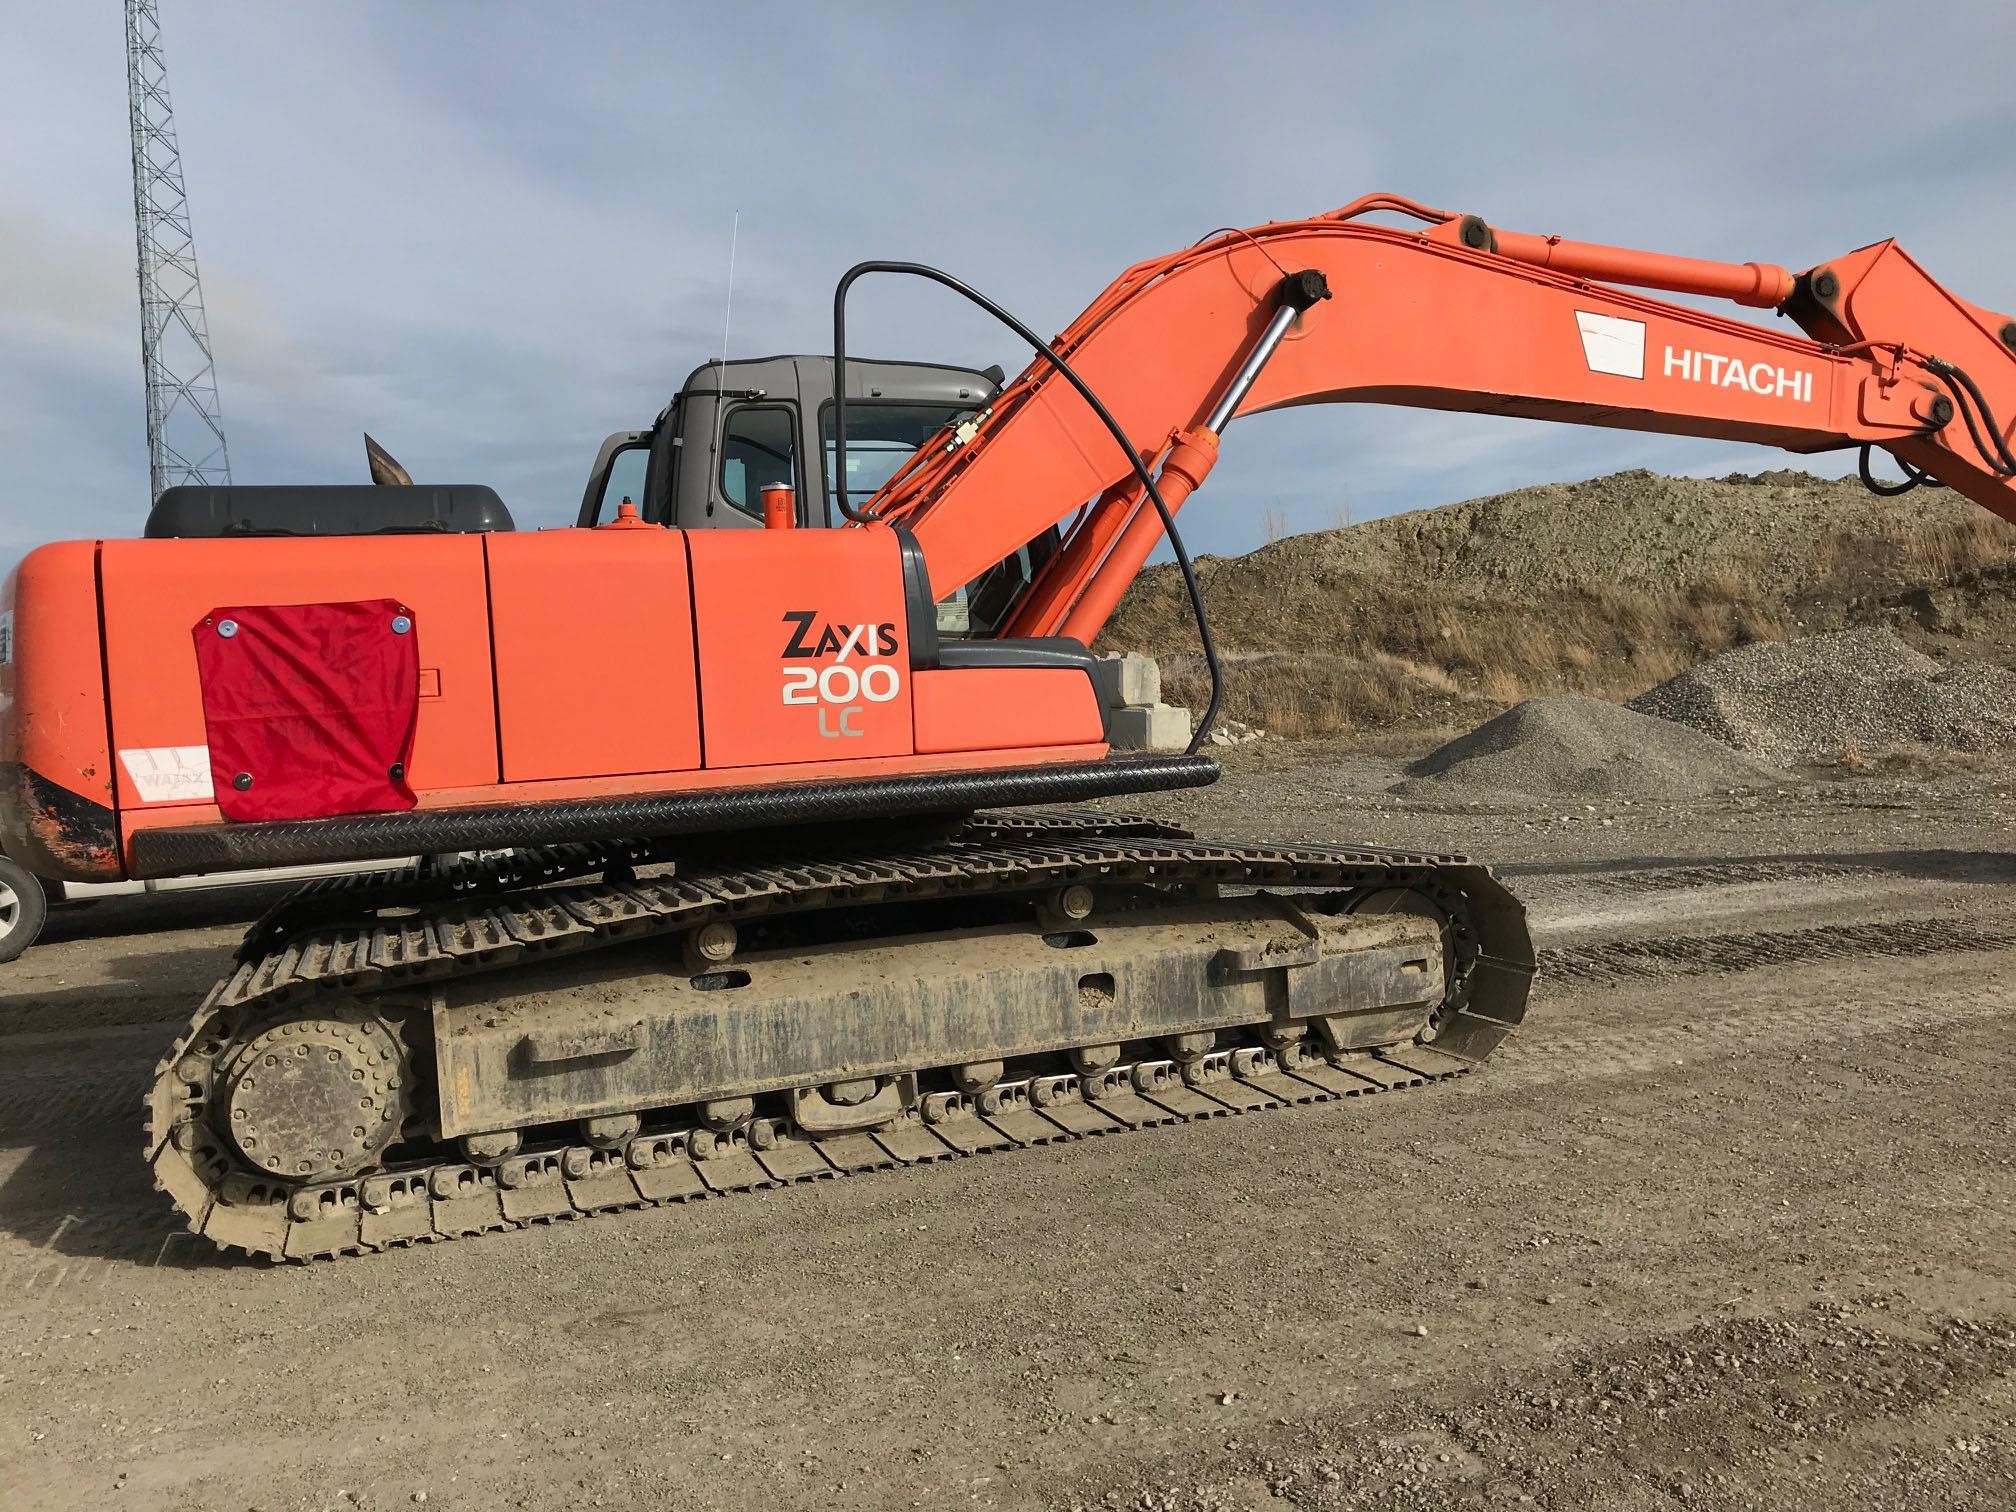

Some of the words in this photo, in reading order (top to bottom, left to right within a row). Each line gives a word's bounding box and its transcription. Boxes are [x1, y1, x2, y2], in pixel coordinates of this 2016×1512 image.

[1664, 346, 1812, 402] HITACHI
[781, 611, 898, 662] ZAXIS
[783, 664, 900, 704] 200
[818, 706, 864, 737] LC
